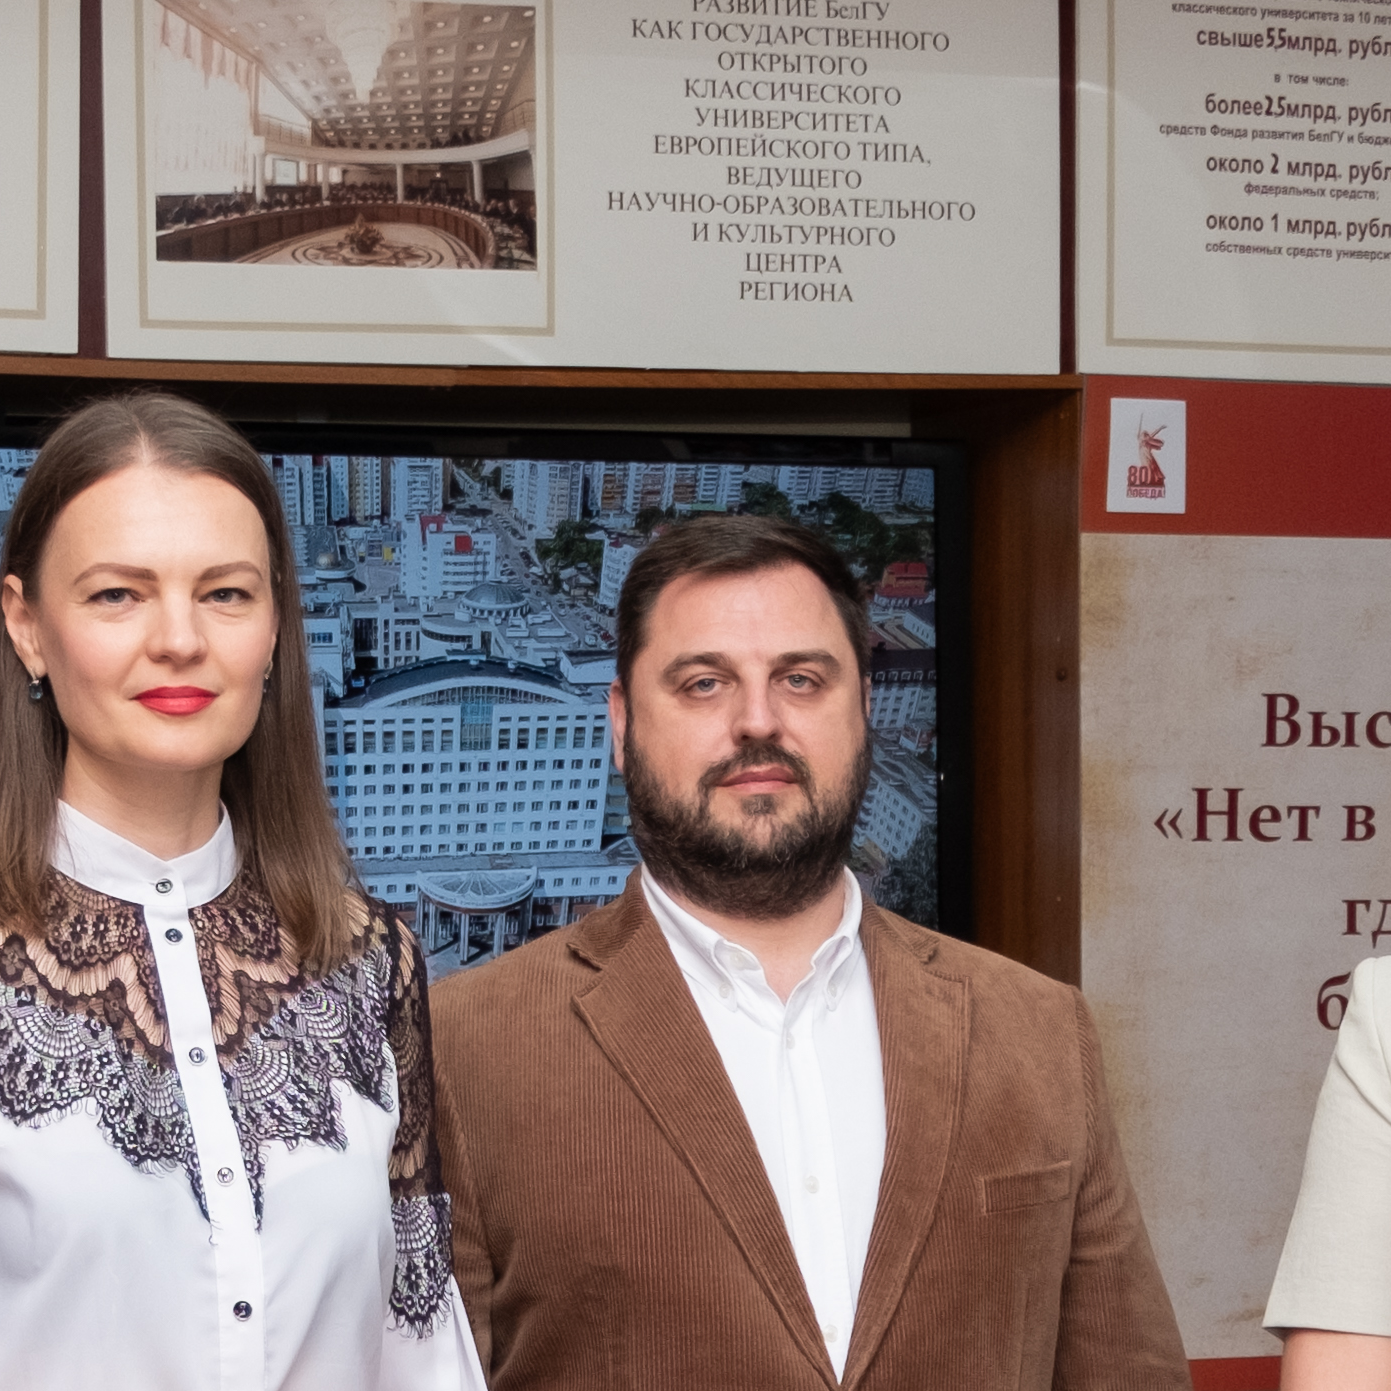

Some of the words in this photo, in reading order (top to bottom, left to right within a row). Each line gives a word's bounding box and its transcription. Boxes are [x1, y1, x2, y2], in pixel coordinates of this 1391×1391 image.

[692, 0, 818, 17] РАЗВИТИЕ
[826, 1, 889, 21] БелГУ
[1172, 3, 1257, 16] классического
[1260, 7, 1339, 21] университета
[1359, 12, 1370, 24] 10
[1373, 15, 1391, 25] лет
[632, 19, 683, 40] КАК
[691, 21, 950, 52] ГОСУДАРСТВЕННОГО
[718, 51, 867, 76] ОТКРЫТОГО
[684, 79, 901, 106] КЛАССИЧЕСКОГО
[695, 108, 890, 133] УНИВЕРСИТЕТА
[1159, 124, 1206, 137] средств
[1210, 125, 1248, 138] Фонда
[1252, 127, 1305, 142] развития
[1308, 129, 1344, 144] БелГУ
[654, 134, 850, 161] ЕВРОПЕЙСКОГО
[858, 141, 931, 165] ТИПА,
[727, 166, 862, 189] ВЕДУЩЕГО
[1206, 155, 1264, 174] около
[1271, 153, 1280, 174] 2
[1287, 159, 1342, 182] млрд.
[608, 191, 976, 221] НАУЧНО-ОБРАЗОВАТЕЛЬНОГО
[692, 223, 709, 242] И
[718, 223, 896, 247] КУЛЬТУРНОГО
[1206, 213, 1264, 232] около
[1271, 213, 1279, 231] 1
[1287, 217, 1342, 239] млрд.
[745, 253, 843, 275] ЦЕНТРА
[739, 281, 854, 302] РЕГИОНА
[1154, 787, 1321, 842] «Нет
[1341, 805, 1376, 842] в
